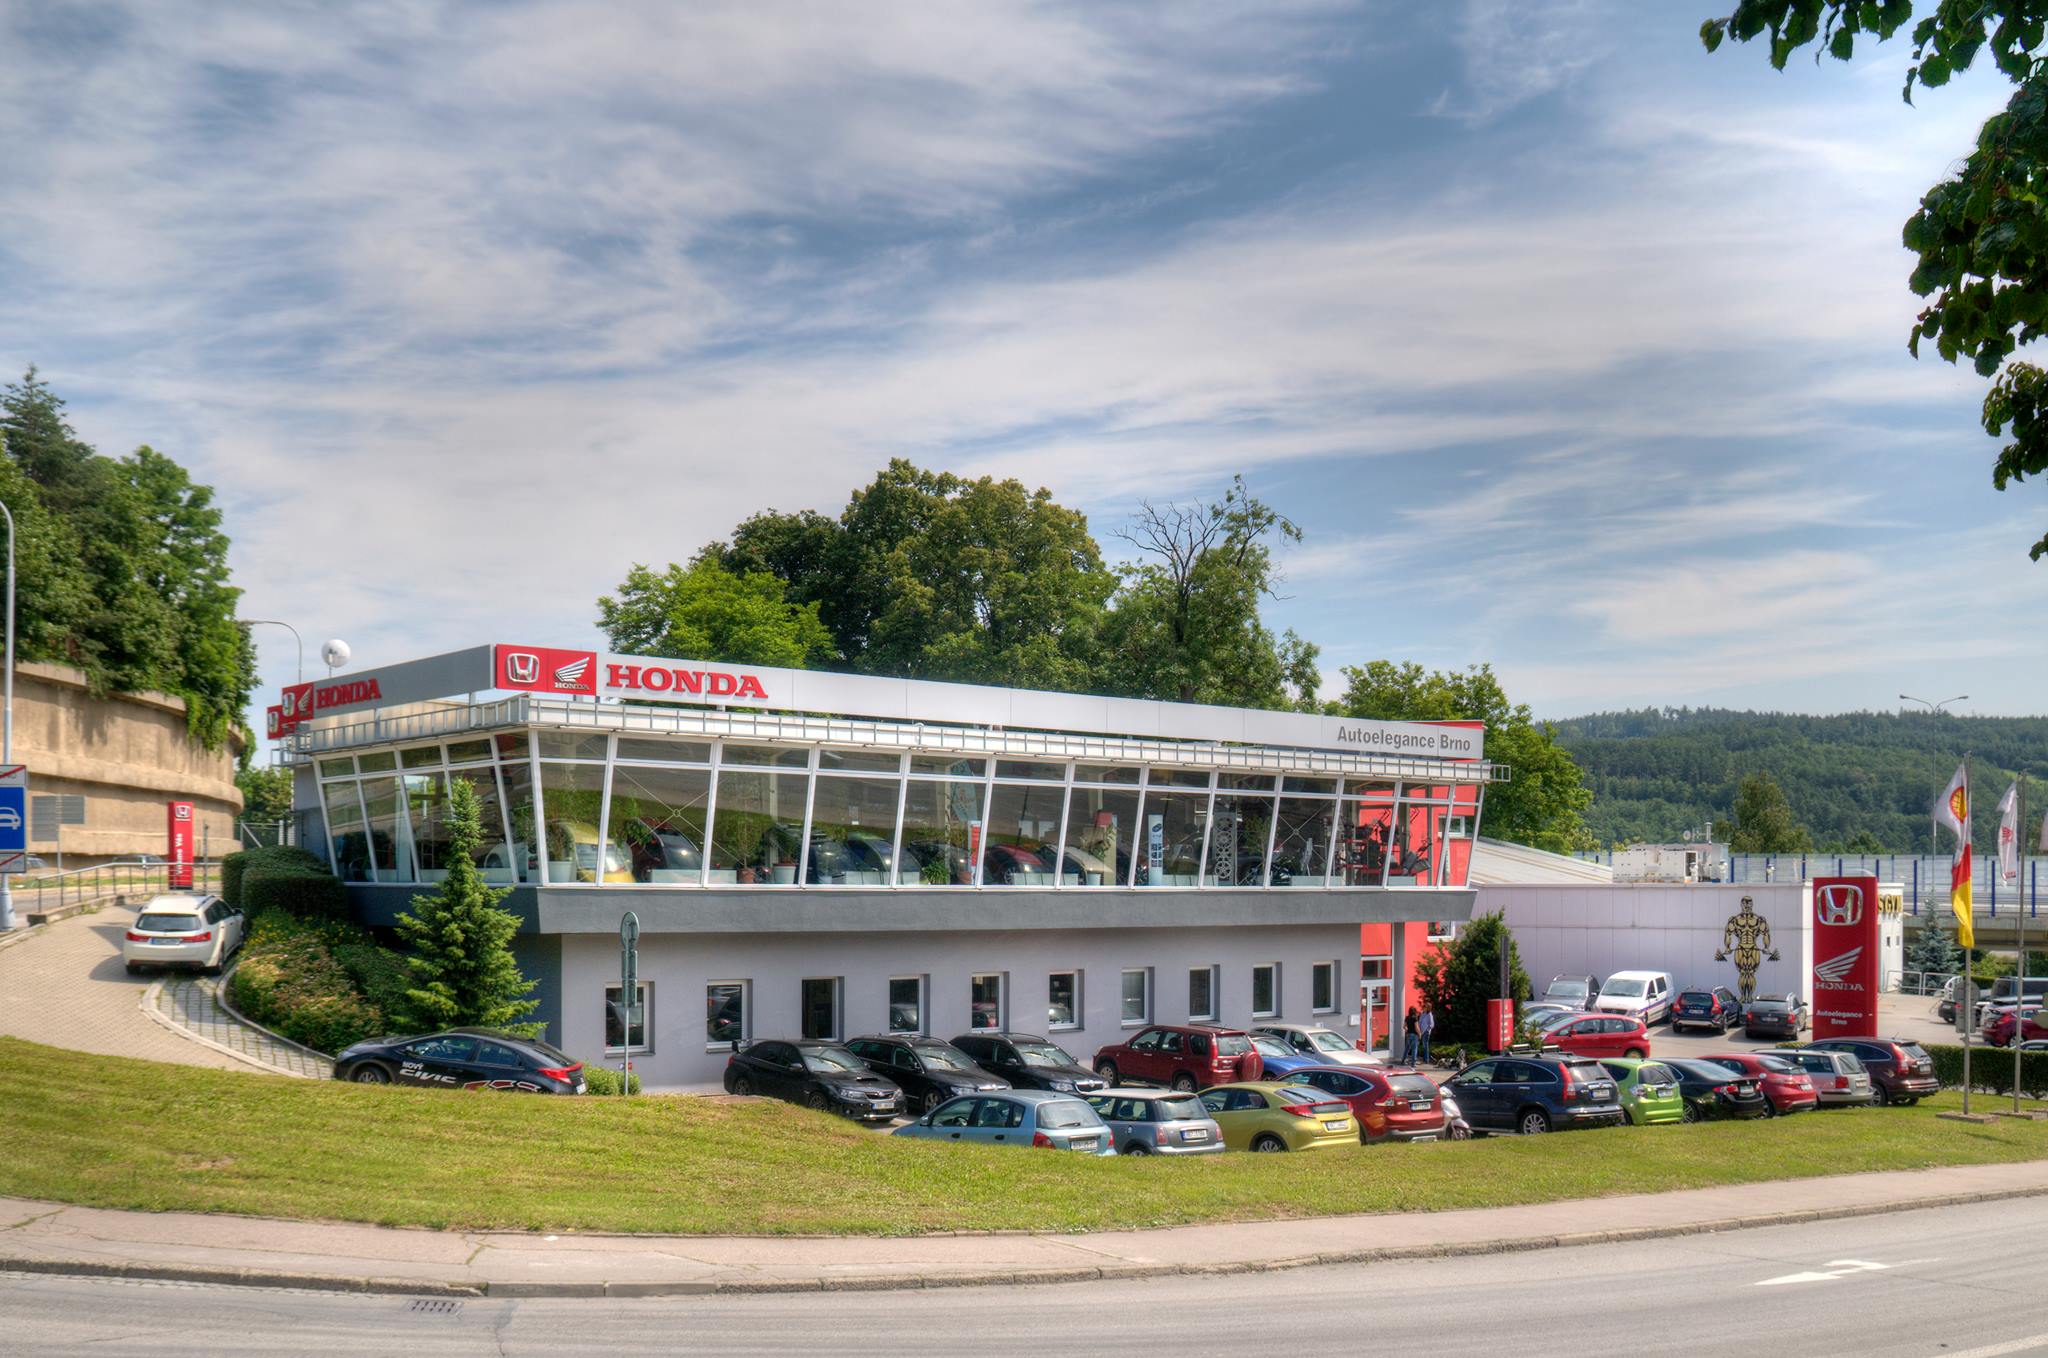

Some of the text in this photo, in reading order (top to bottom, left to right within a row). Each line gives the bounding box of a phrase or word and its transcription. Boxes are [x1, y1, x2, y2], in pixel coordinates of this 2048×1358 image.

[554, 682, 591, 691] HONDA
[606, 664, 769, 699] HONDA
[316, 678, 382, 709] HONDA
[1337, 726, 1471, 751] Autoelegance Brno
[1815, 982, 1865, 991] HONDA
[399, 1068, 457, 1084] CIVIC
